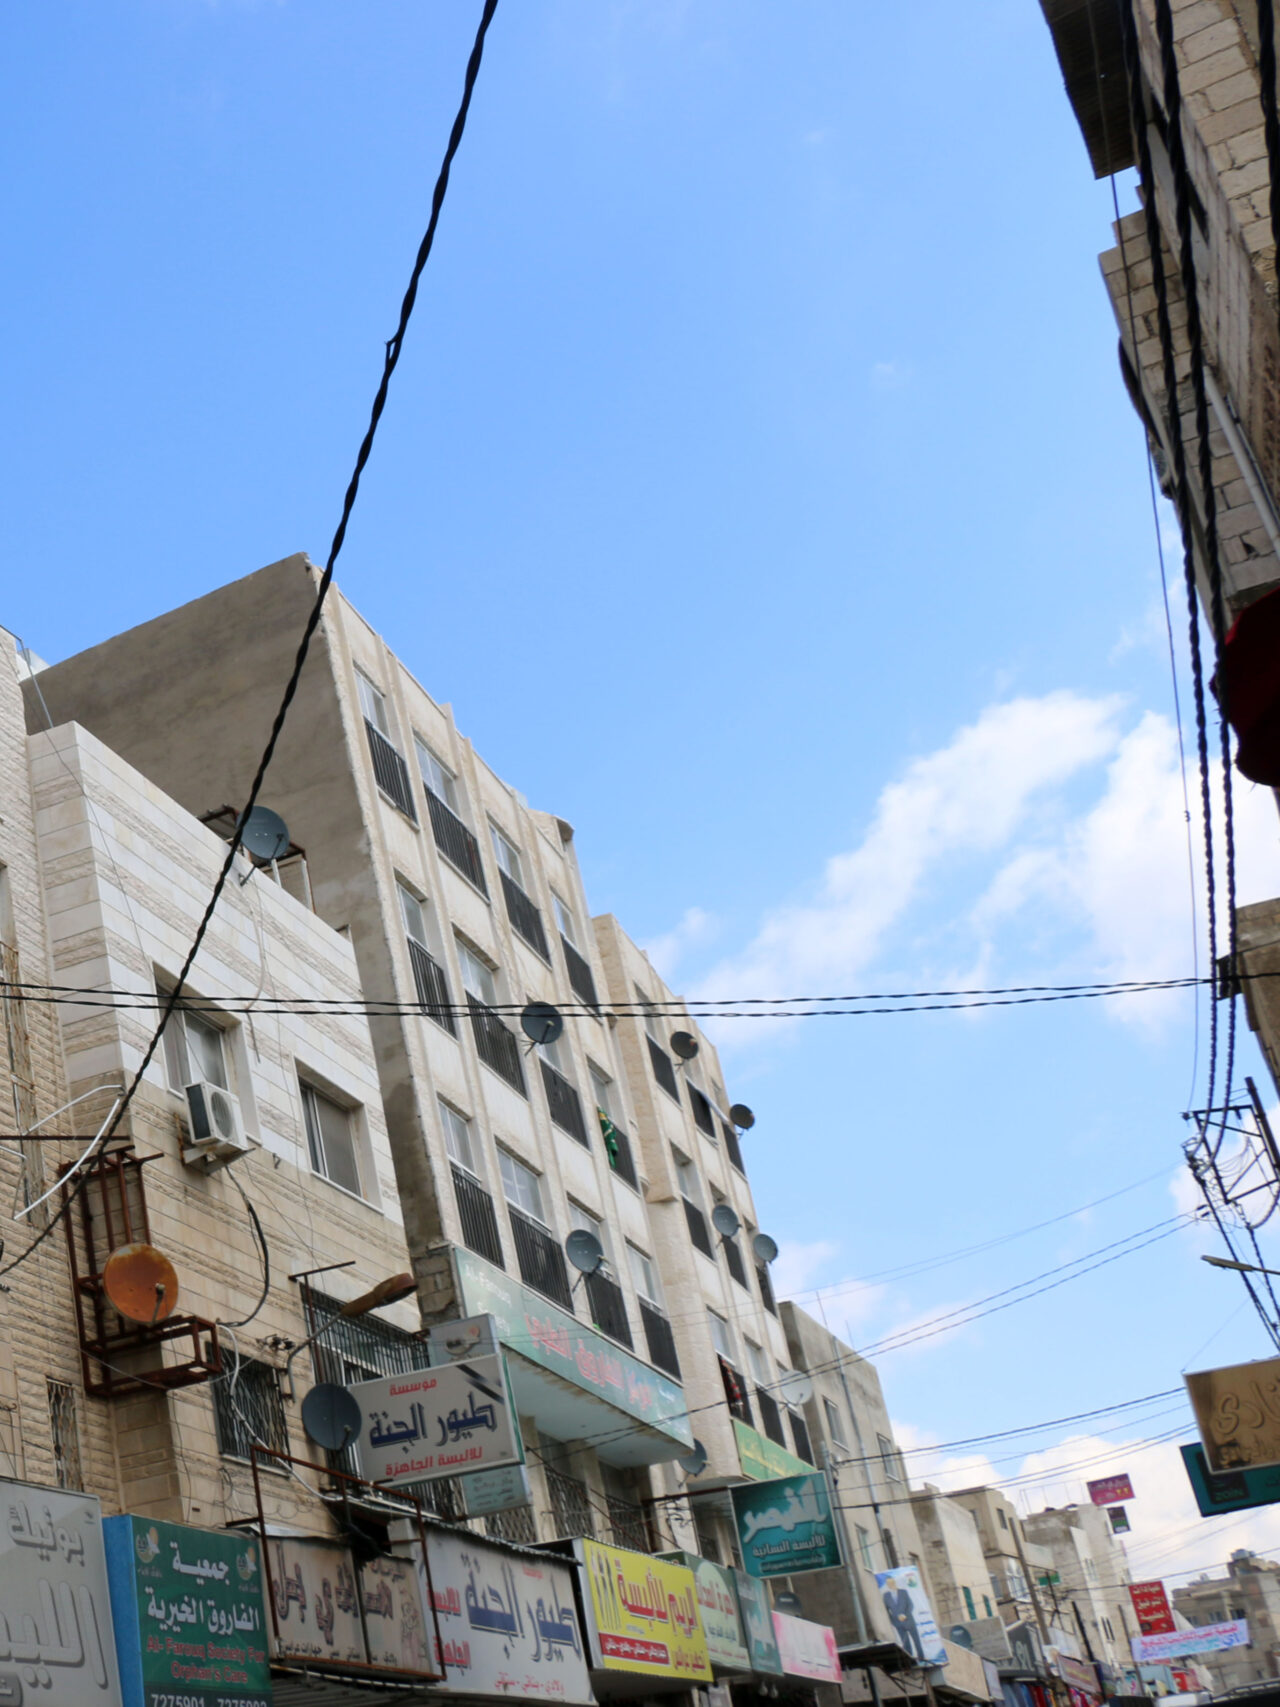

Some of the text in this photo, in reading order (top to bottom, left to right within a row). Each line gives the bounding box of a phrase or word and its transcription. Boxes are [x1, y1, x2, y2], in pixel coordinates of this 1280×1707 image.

[368, 1391, 499, 1454] طيور الجنة
[385, 1456, 434, 1477] الجاهزة
[8, 1500, 85, 1567] بوتيك
[170, 1541, 230, 1585] جمعية
[145, 1586, 260, 1635] الفاروق الخيرية
[207, 1642, 245, 1665] Society
[223, 1666, 248, 1684] Care
